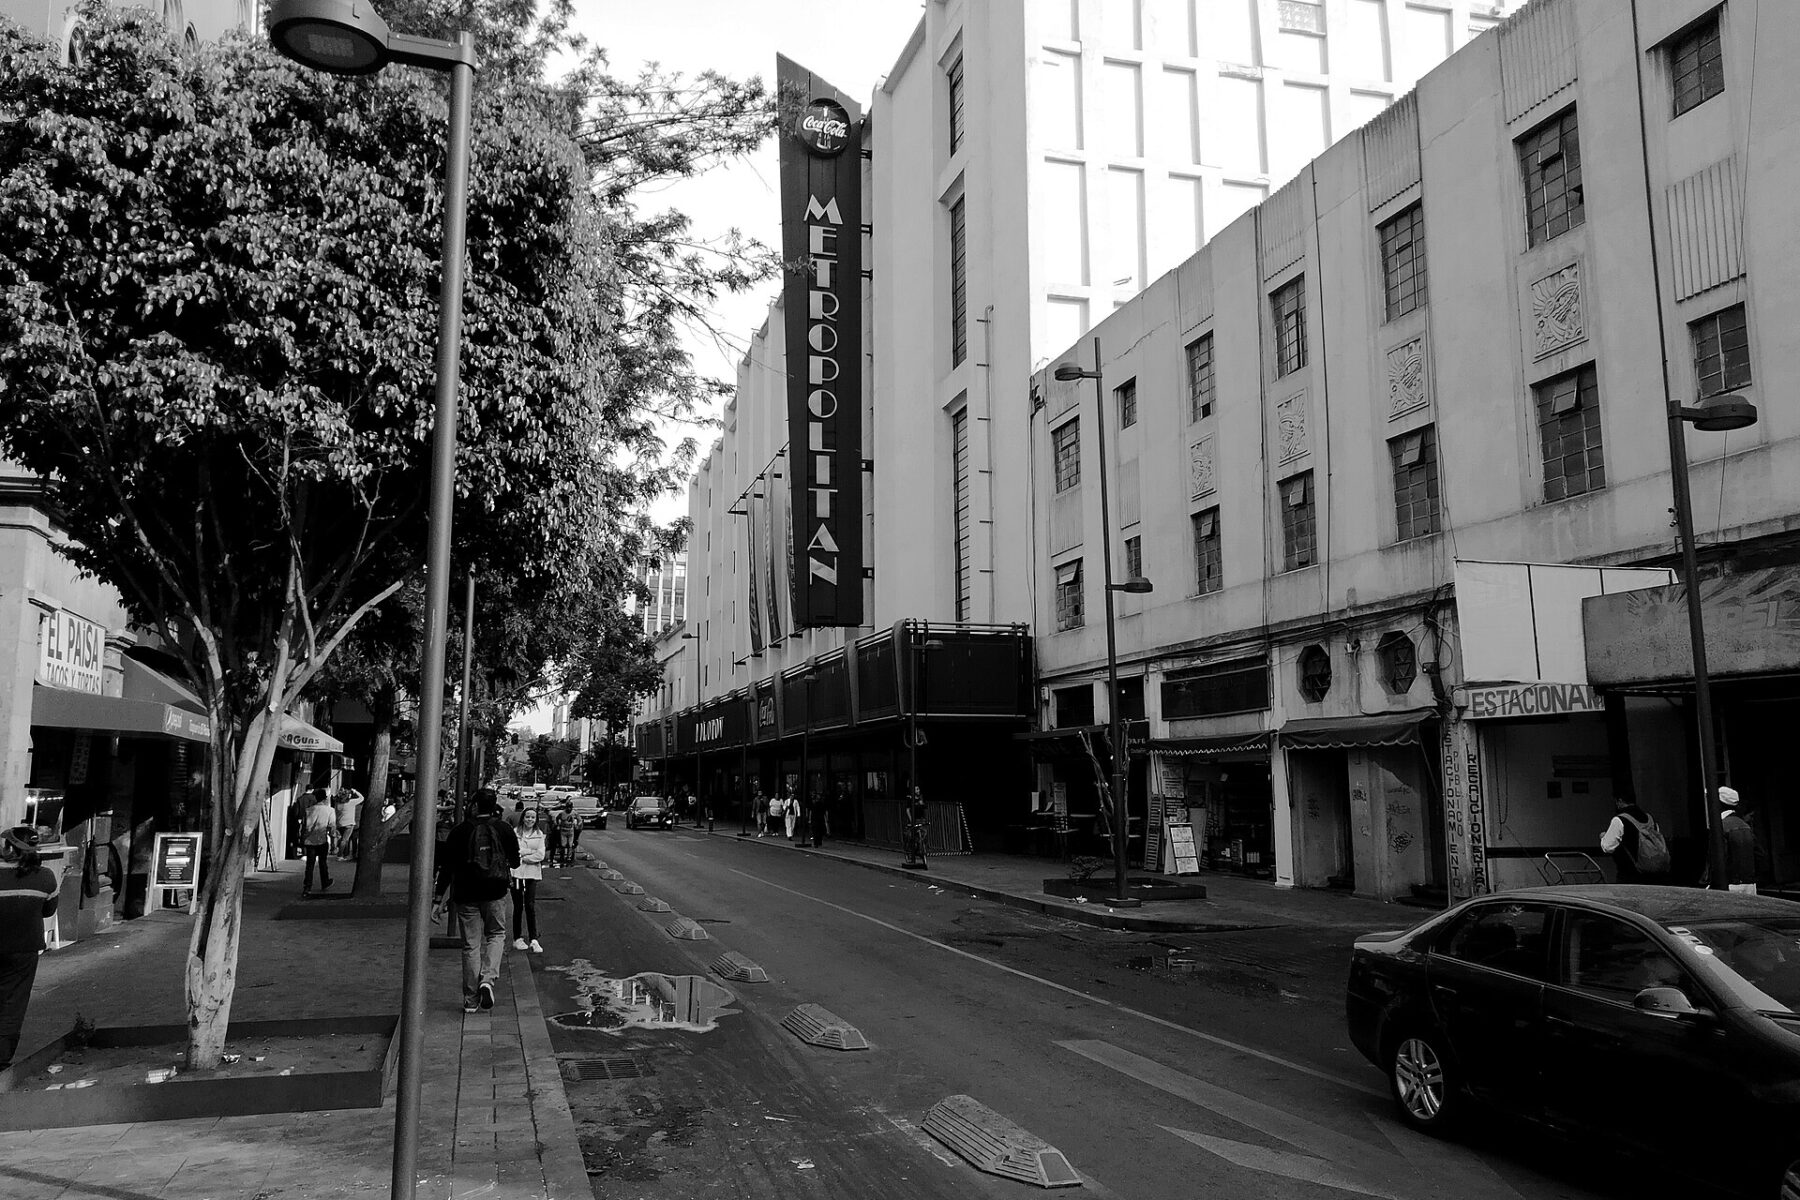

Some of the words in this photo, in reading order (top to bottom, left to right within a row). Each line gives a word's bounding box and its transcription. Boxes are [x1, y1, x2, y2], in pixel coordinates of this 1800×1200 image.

[803, 194, 843, 586] METROPOLITAN
[47, 613, 63, 660] EL
[47, 663, 69, 685] TACOS
[1453, 750, 1463, 837] PUBLICO
